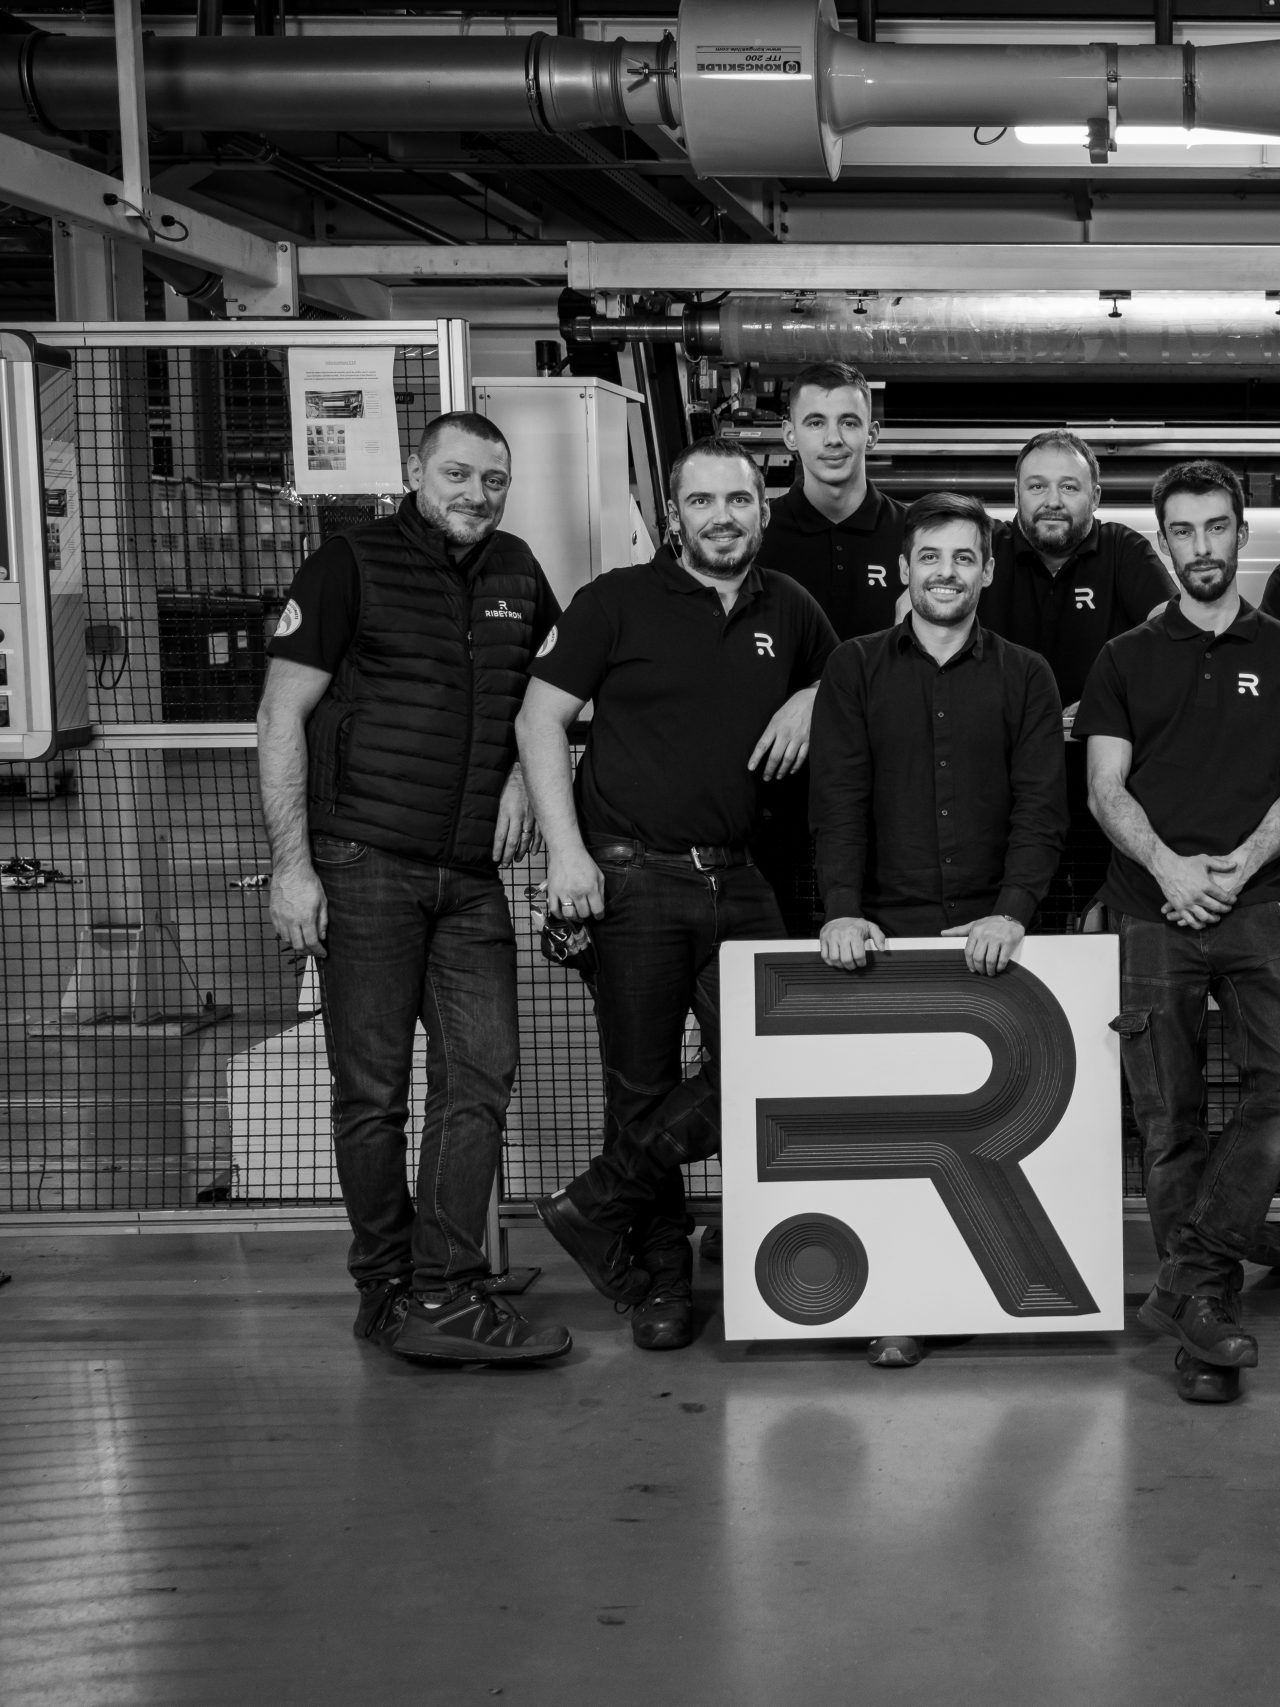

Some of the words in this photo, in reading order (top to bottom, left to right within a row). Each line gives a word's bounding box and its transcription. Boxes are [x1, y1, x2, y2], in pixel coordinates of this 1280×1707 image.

[696, 63, 782, 72] KONGSKILDE
[484, 610, 522, 620] RIBEYRON
[754, 948, 1100, 1326] R
